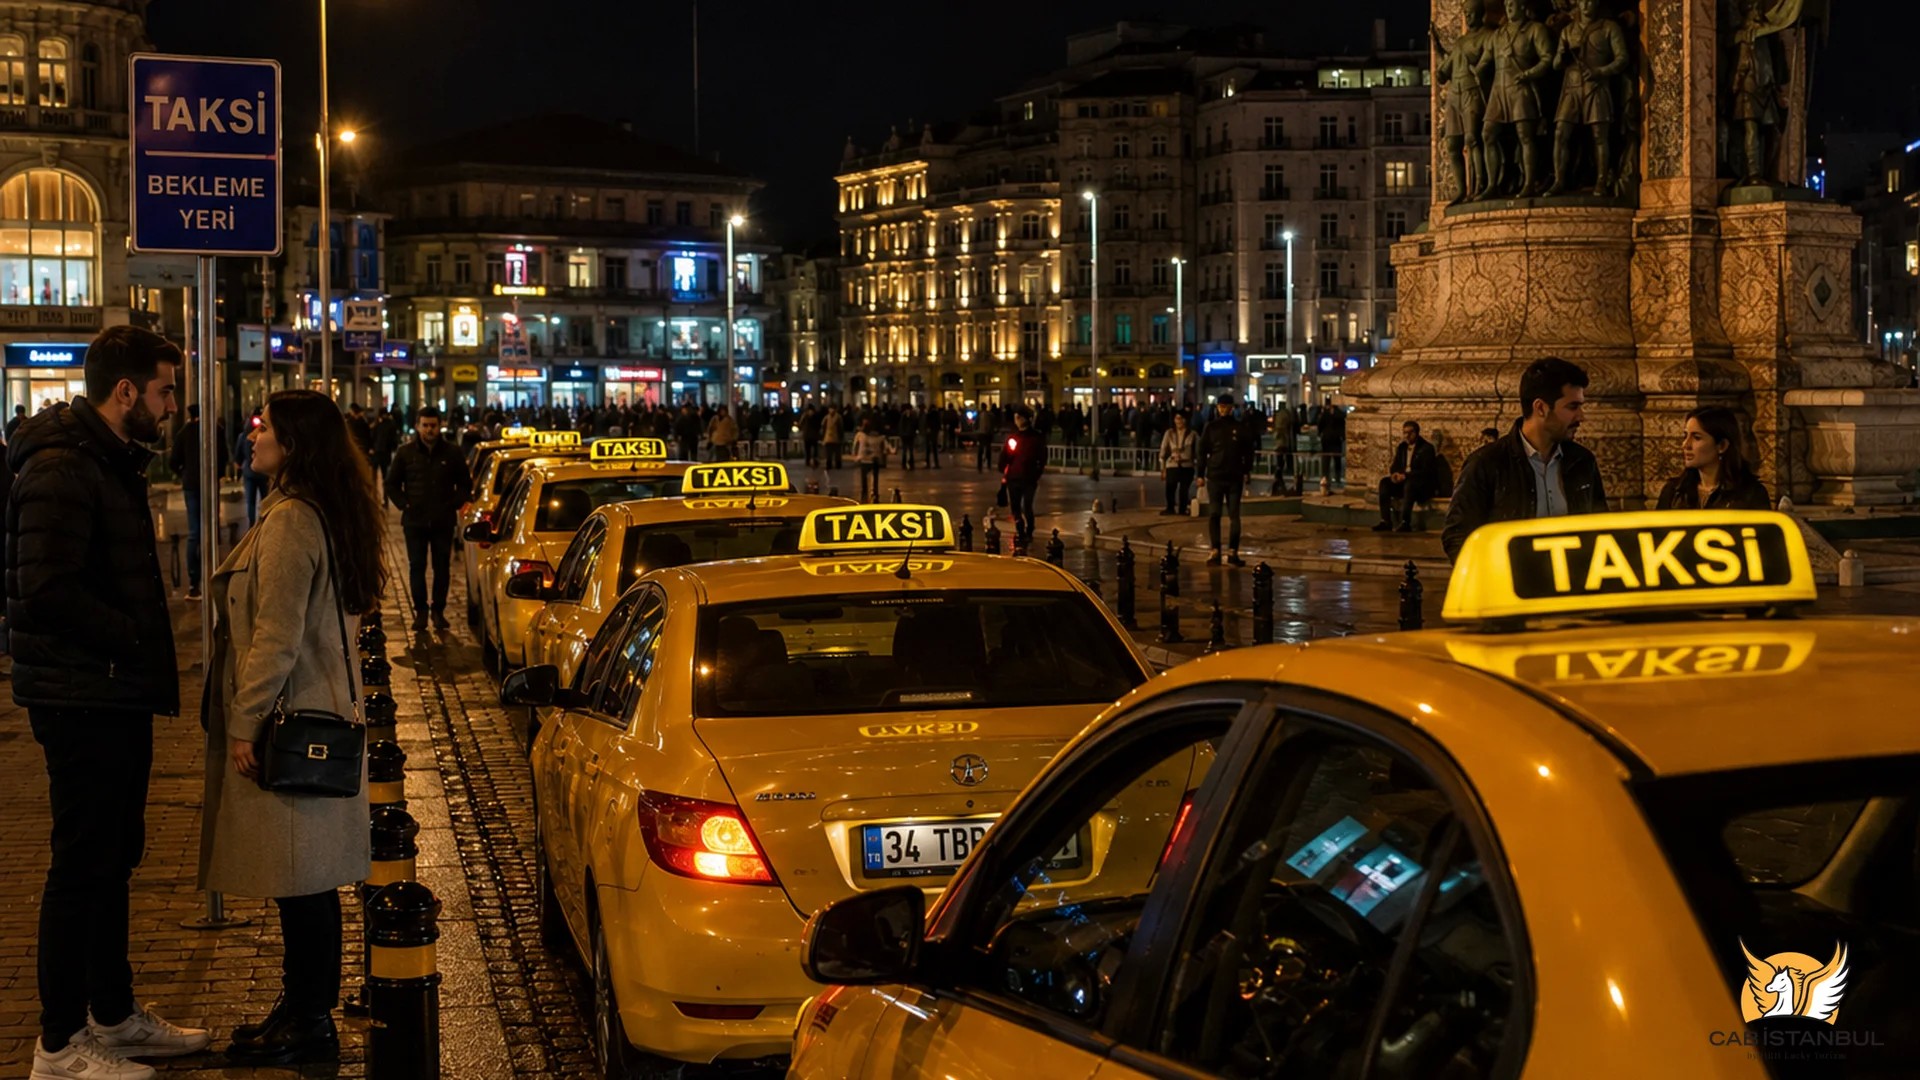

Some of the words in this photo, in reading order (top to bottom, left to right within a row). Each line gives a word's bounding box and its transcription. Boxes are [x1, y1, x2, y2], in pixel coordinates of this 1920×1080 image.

[144, 91, 266, 135] TAKSİ
[148, 175, 265, 198] BEKLEME
[179, 205, 235, 231] YERİ
[885, 829, 920, 863] 34
